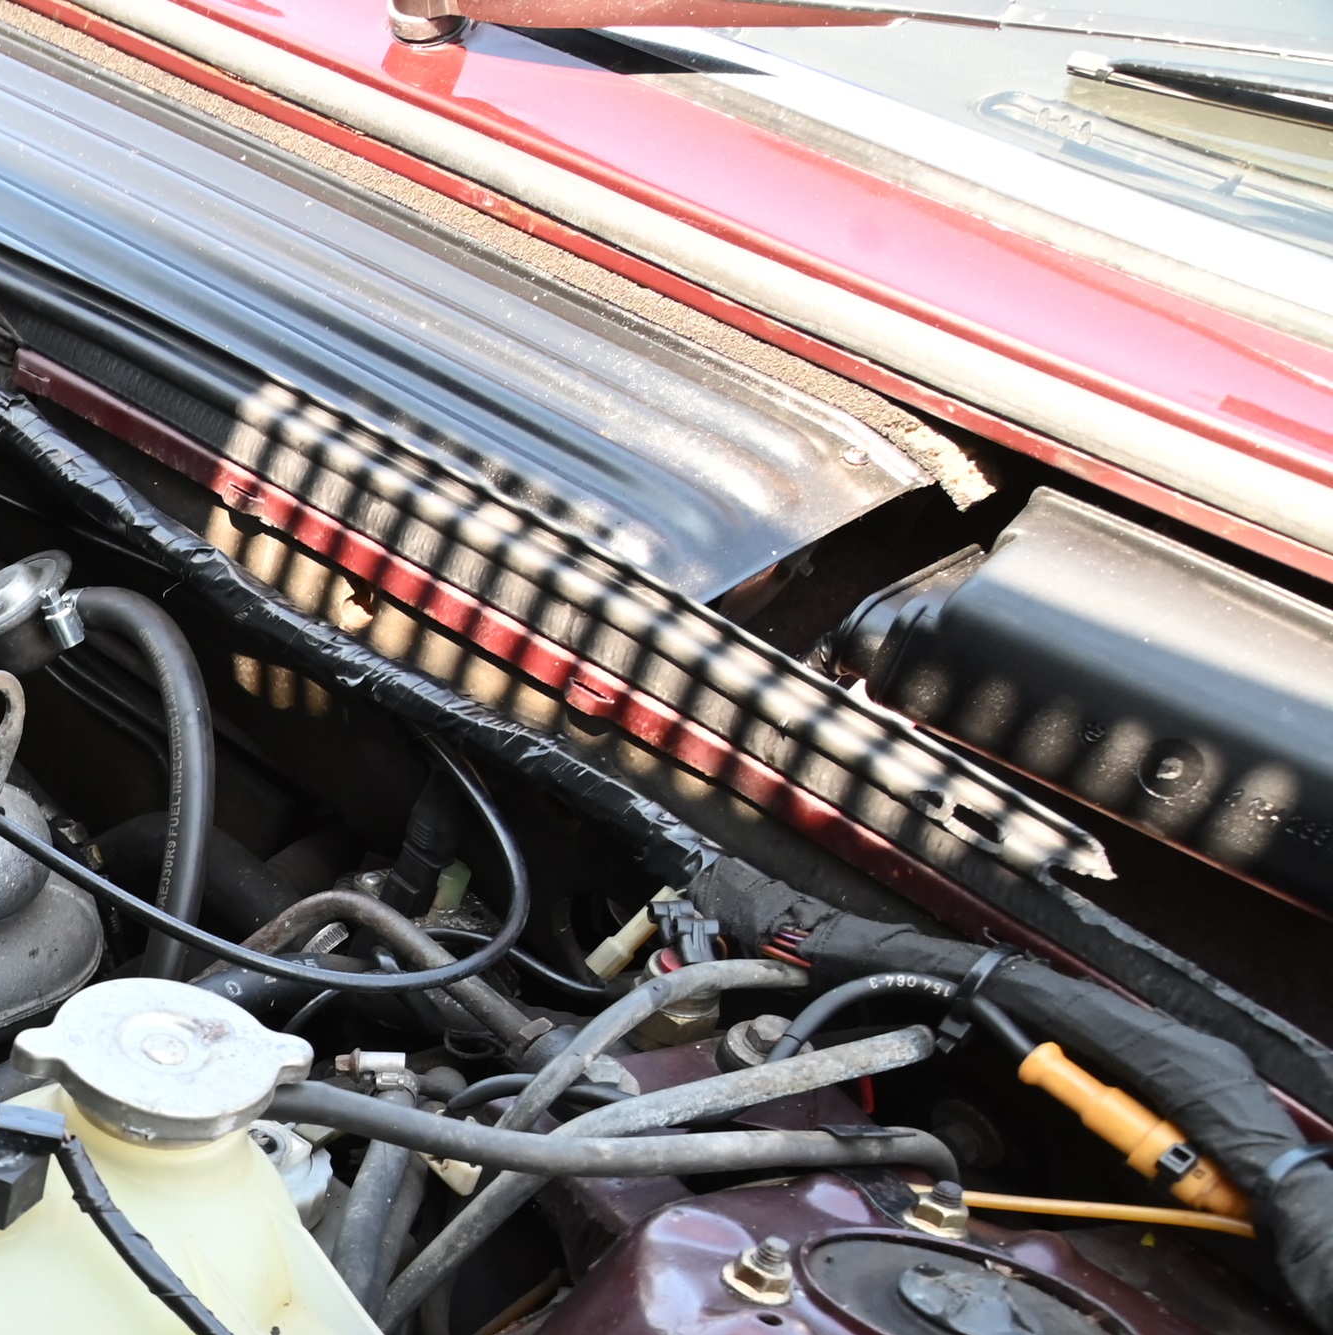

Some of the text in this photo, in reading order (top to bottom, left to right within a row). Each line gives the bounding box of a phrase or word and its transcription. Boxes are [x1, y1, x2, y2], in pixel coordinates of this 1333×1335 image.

[170, 714, 182, 794] INJECTION
[167, 797, 181, 835] FUEL
[868, 974, 918, 989] 064-3
